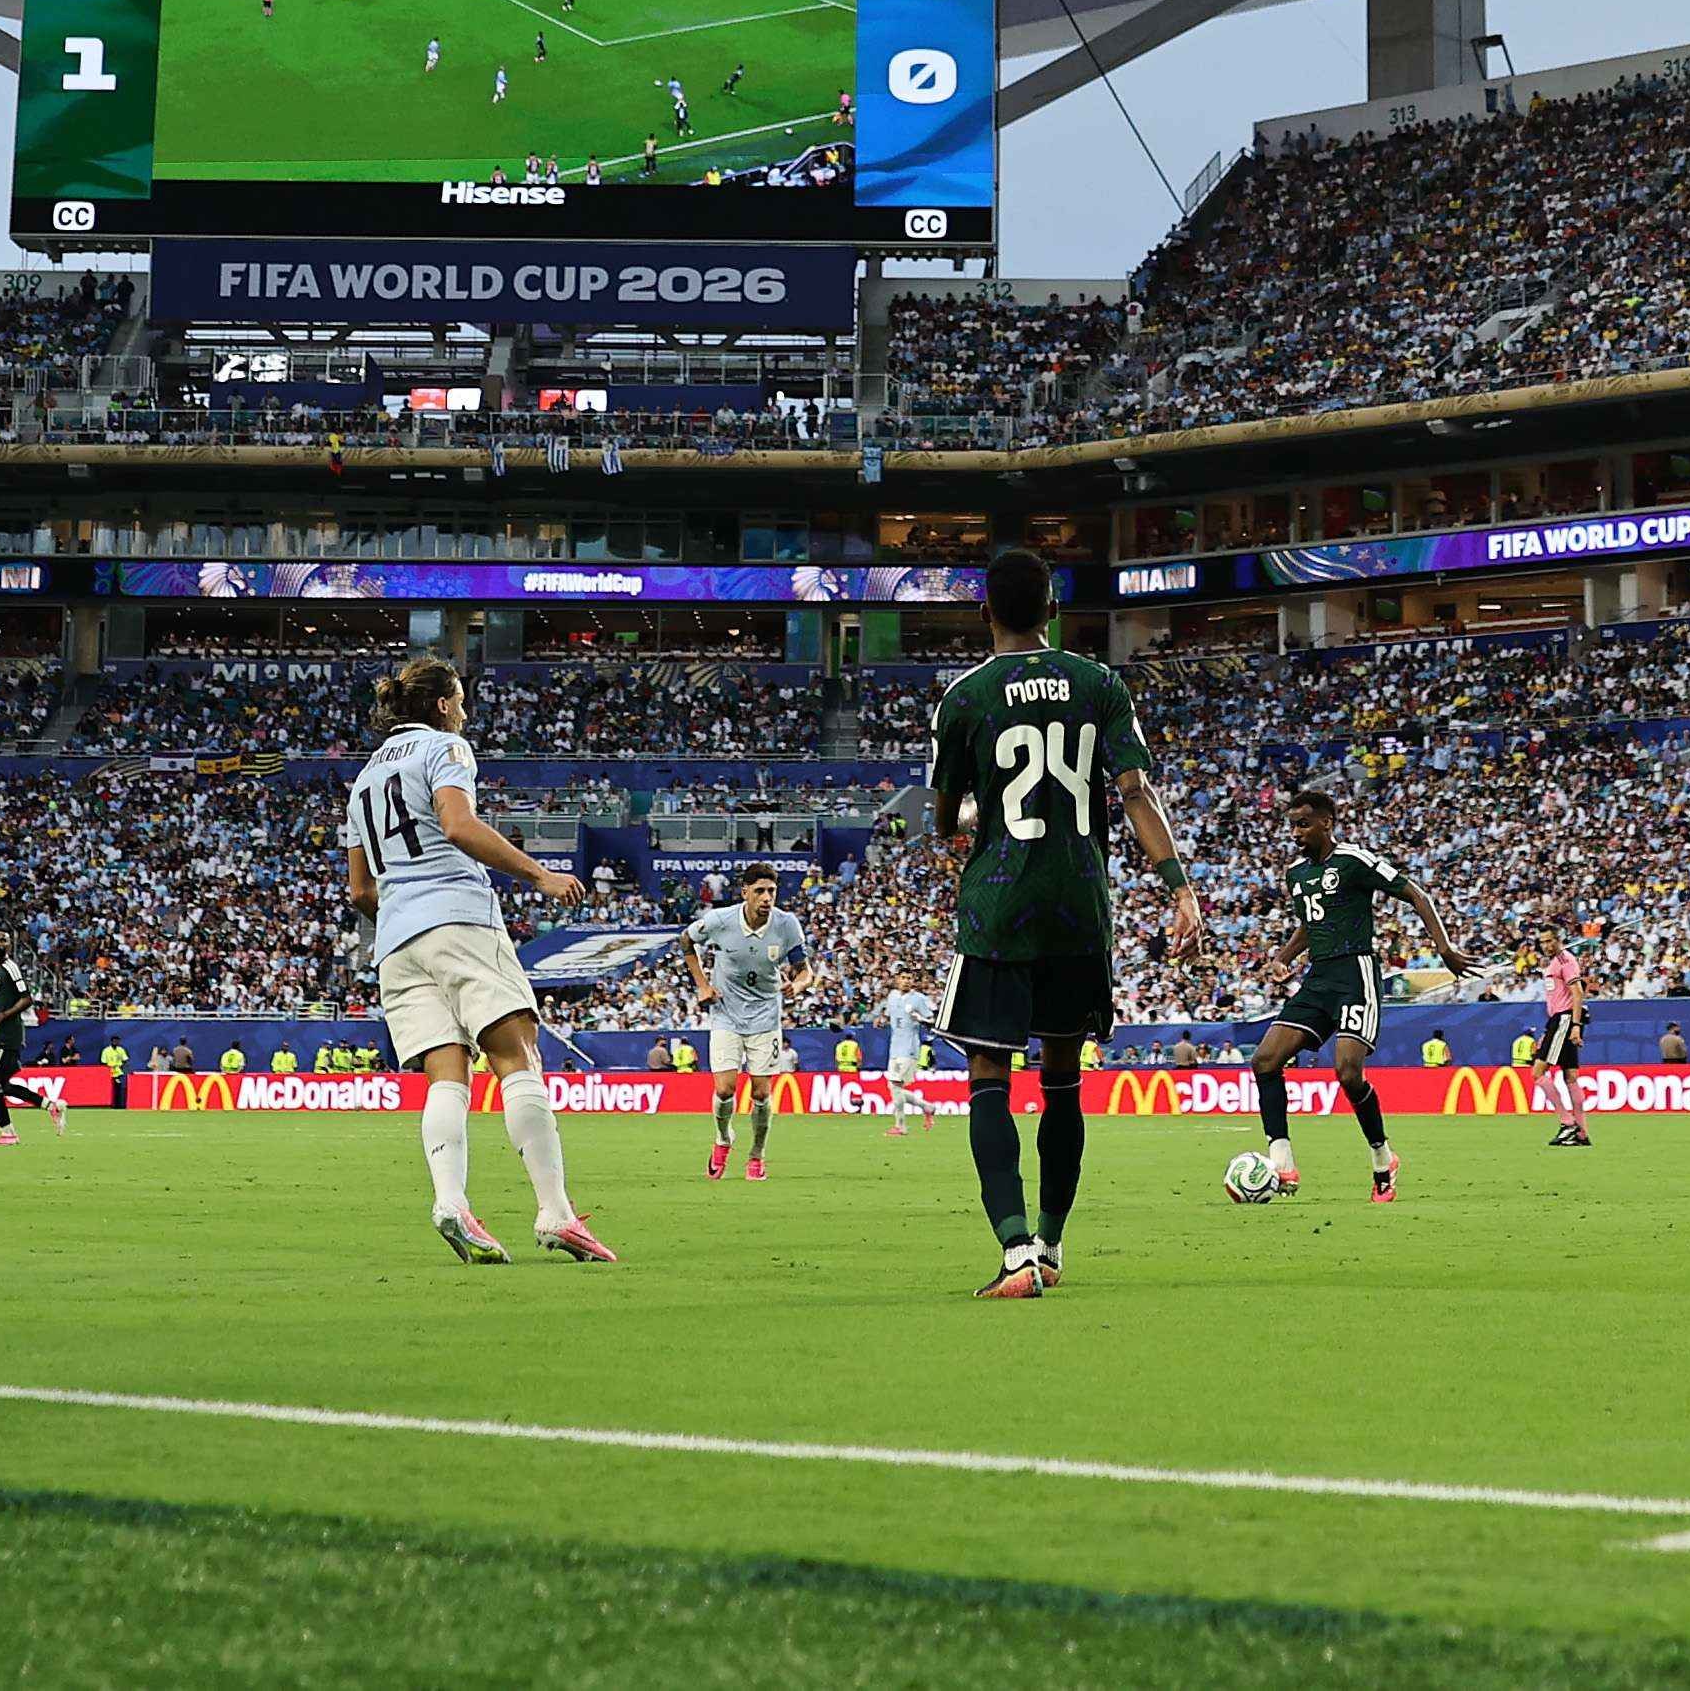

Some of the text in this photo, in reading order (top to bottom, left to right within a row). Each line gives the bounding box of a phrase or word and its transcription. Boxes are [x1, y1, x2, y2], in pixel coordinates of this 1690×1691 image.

[62, 36, 117, 90] 1
[888, 49, 957, 105] 0
[1388, 105, 1417, 125] 313
[441, 182, 566, 205] Hisense
[59, 207, 90, 226] CC
[910, 215, 942, 234] CC
[4, 273, 43, 292] 309
[219, 262, 787, 303] FIFA WORLD CUP 2026
[1488, 531, 1544, 560] FIFA
[1547, 521, 1640, 556] WORLD
[523, 571, 643, 596] #FIFAWorldCup
[1118, 565, 1196, 595] MIAMI
[1004, 677, 1070, 707] MOTEB
[995, 722, 1097, 841] 24
[359, 772, 425, 875] 14
[652, 859, 682, 871] FIFA
[683, 859, 732, 872] WORLD
[1303, 893, 1325, 922] 15
[747, 971, 758, 987] 8
[1340, 1004, 1365, 1031] 15
[772, 1038, 779, 1059] 8
[237, 1075, 401, 1111] McDonald's
[1177, 1071, 1341, 1116] cDeliery
